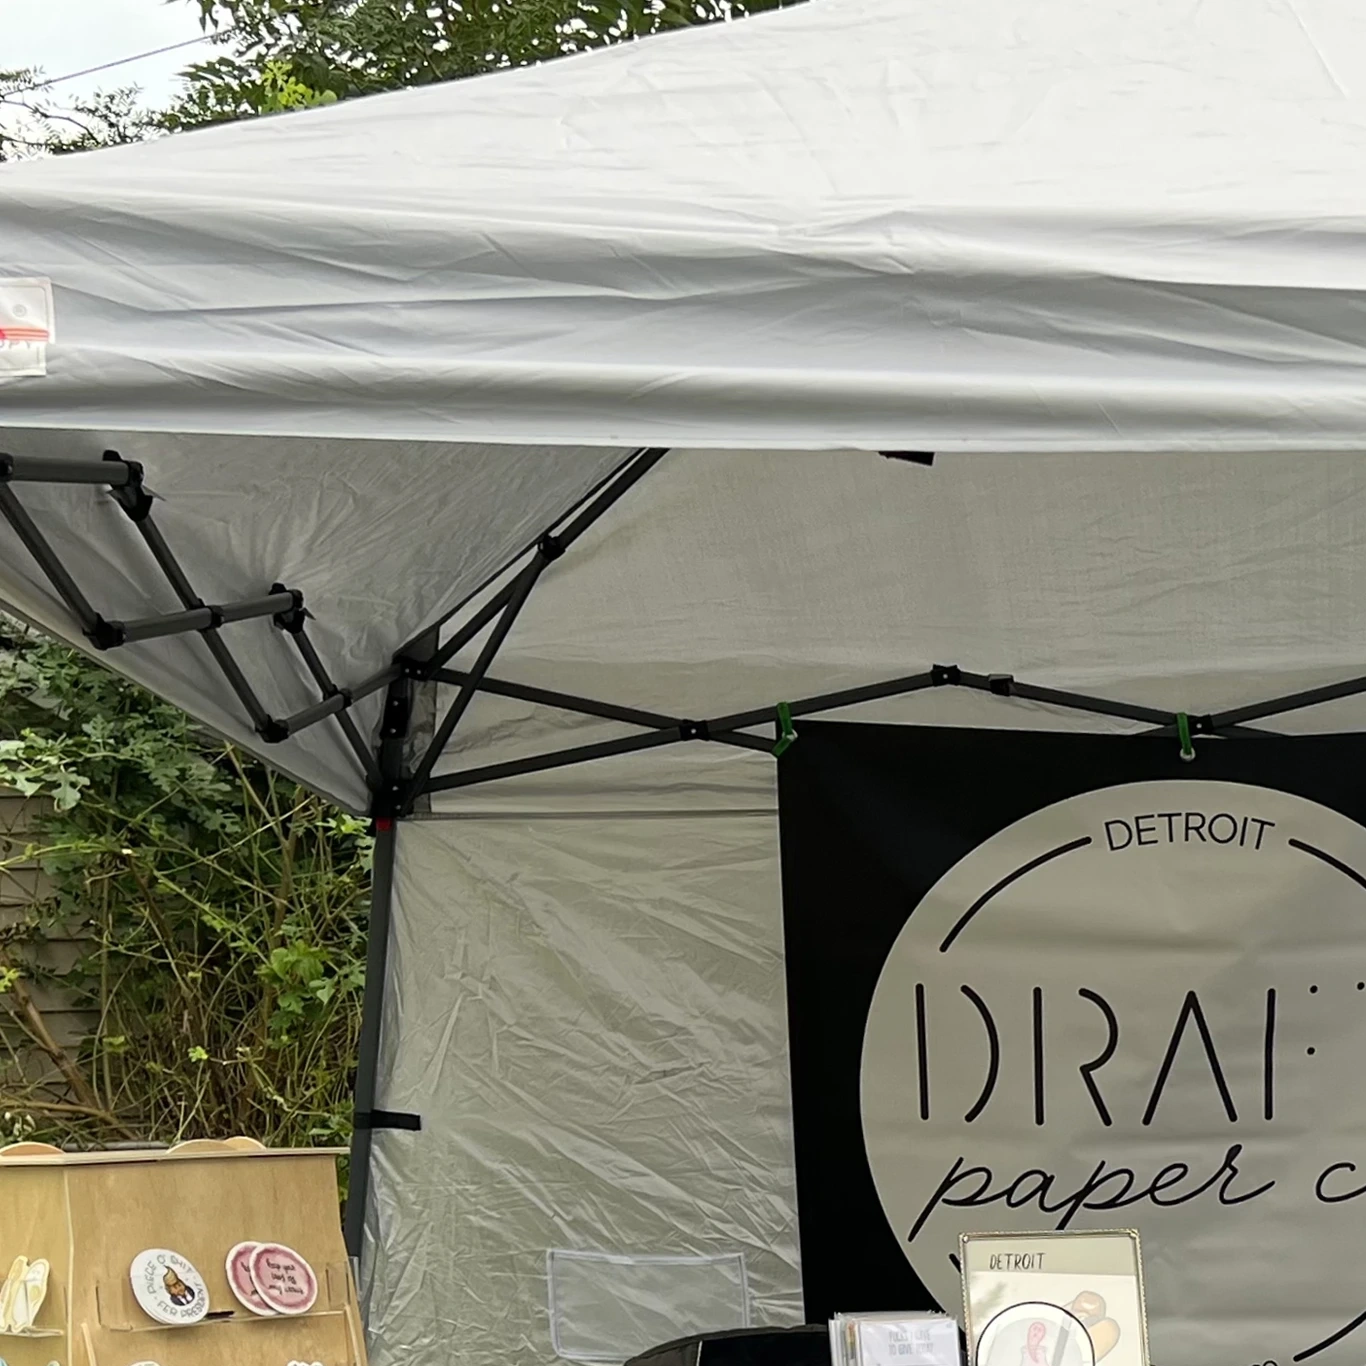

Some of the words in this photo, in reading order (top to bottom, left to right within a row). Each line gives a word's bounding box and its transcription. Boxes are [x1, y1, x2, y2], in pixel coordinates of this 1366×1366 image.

[1104, 812, 1276, 853] DETROIT
[907, 1143, 1276, 1243] paper
[143, 1260, 158, 1295] PIECE
[989, 1252, 1046, 1271] DETROIT
